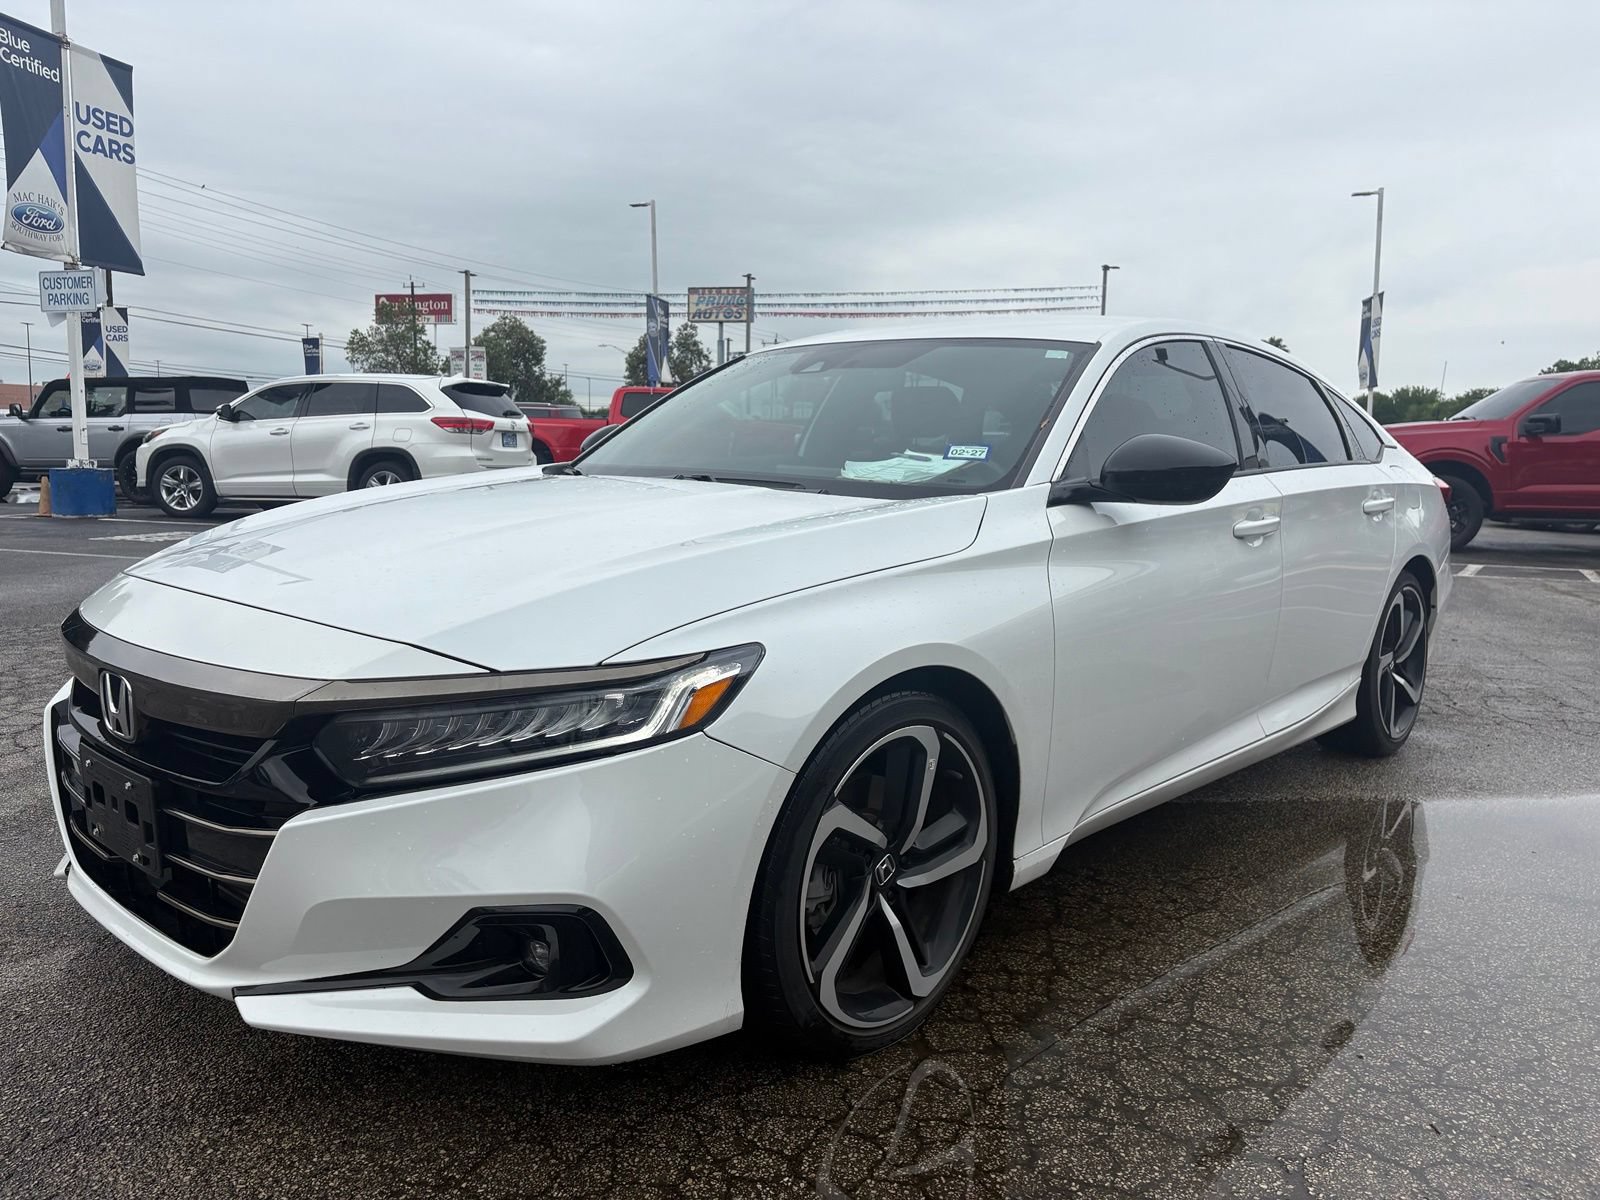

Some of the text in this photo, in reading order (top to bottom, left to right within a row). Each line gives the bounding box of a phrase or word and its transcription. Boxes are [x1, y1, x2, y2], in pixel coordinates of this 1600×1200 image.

[0, 27, 31, 53] Blue
[0, 46, 60, 83] Certified
[75, 101, 134, 138] USED
[76, 130, 136, 165] CARS
[13, 191, 34, 203] MAC
[22, 206, 57, 230] Ford
[10, 220, 48, 242] SOUTHWAY
[42, 276, 93, 290] CUSTOMER
[47, 292, 90, 306] PARKING
[691, 308, 743, 319] AUTOS
[106, 334, 128, 342] CARS
